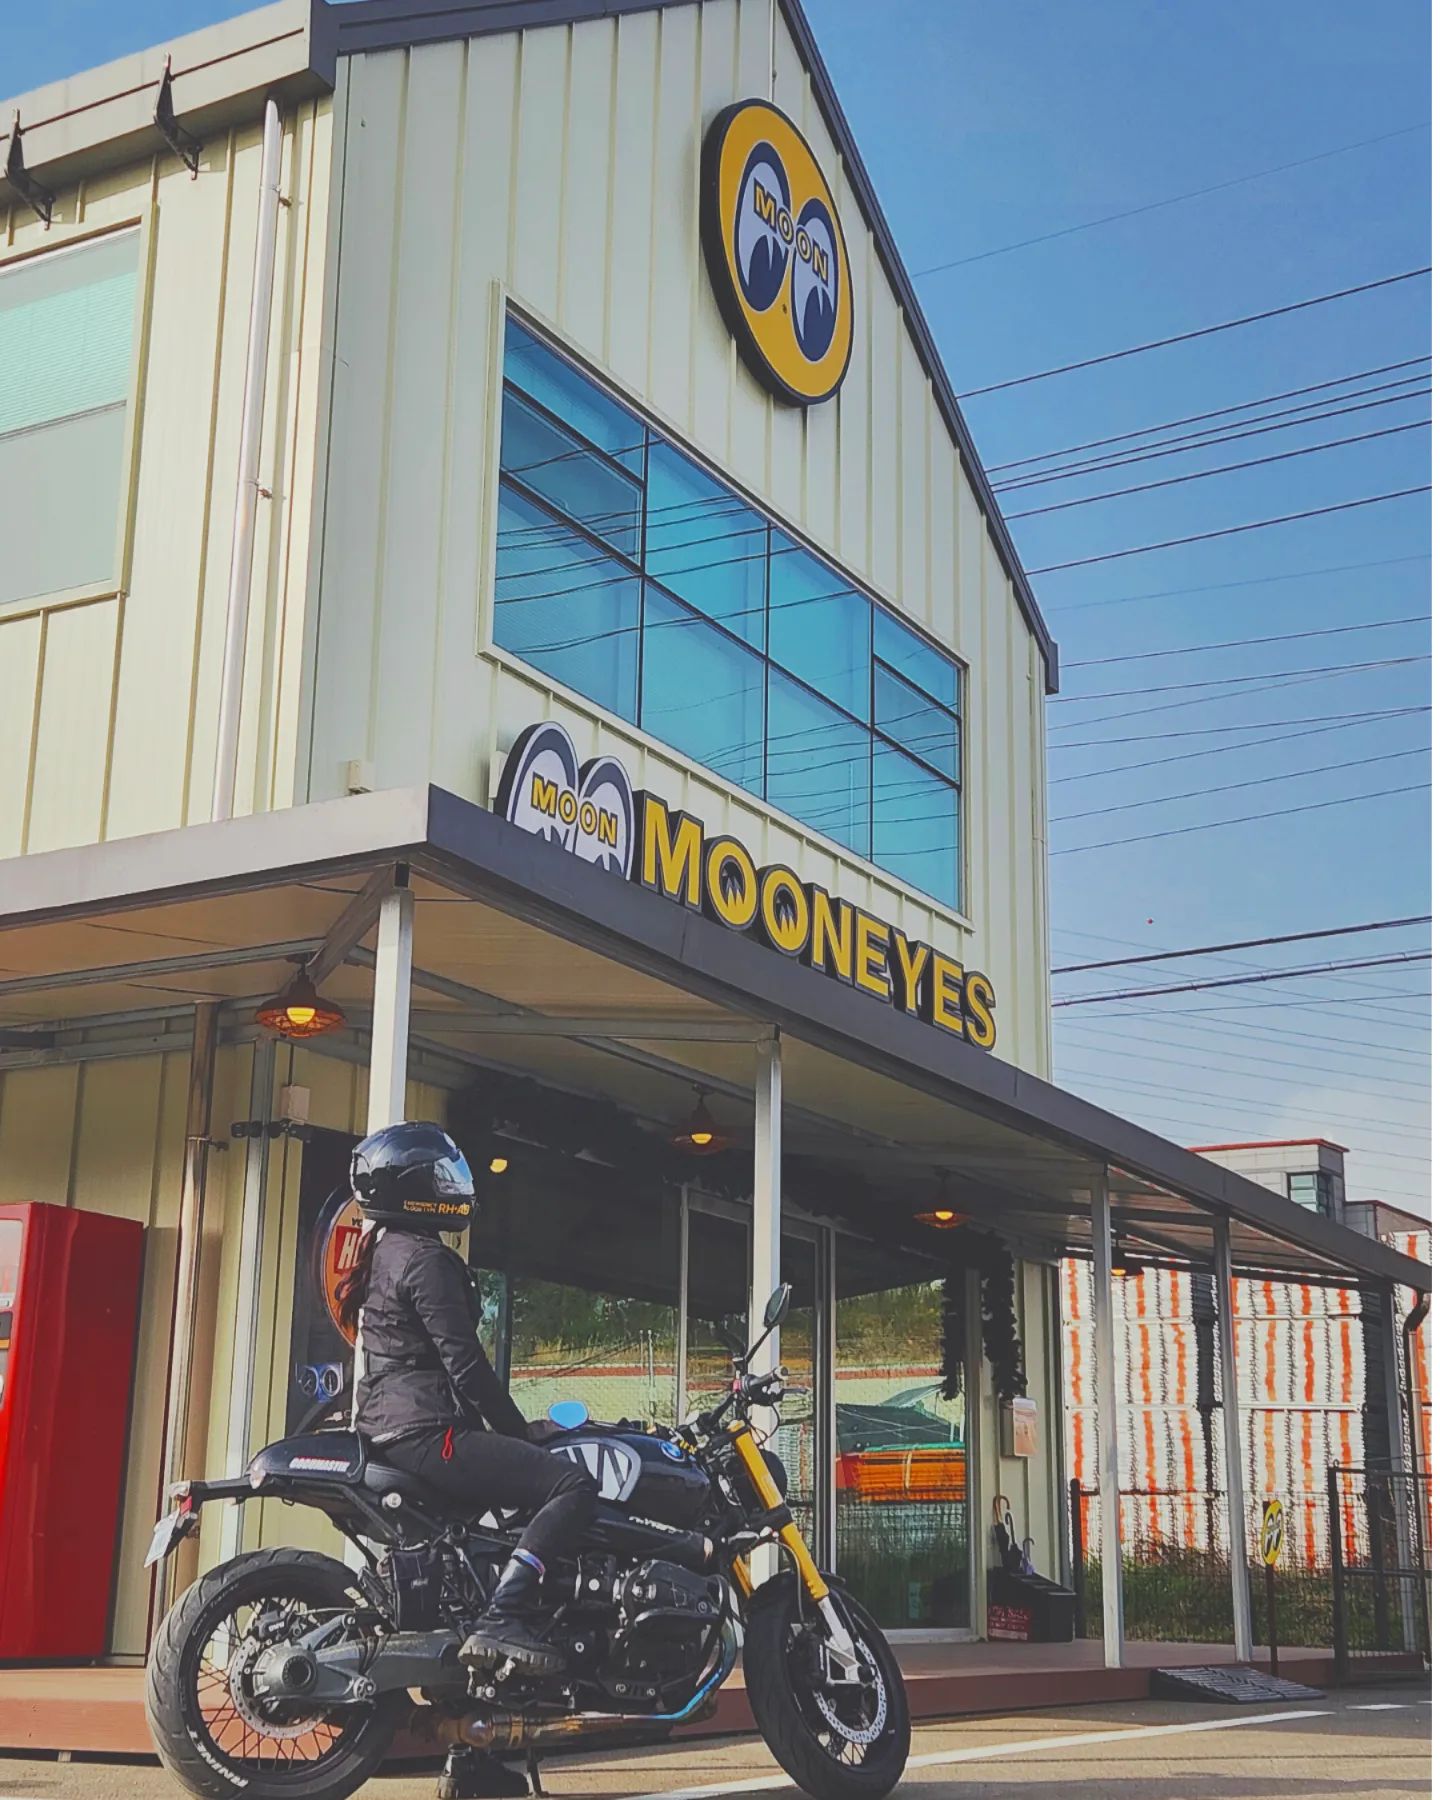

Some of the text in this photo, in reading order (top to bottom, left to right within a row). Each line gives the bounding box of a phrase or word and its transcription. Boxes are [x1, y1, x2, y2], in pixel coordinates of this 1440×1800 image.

[753, 178, 829, 288] MOON
[531, 771, 618, 849] MOON
[640, 793, 997, 1052] MOONEYES
